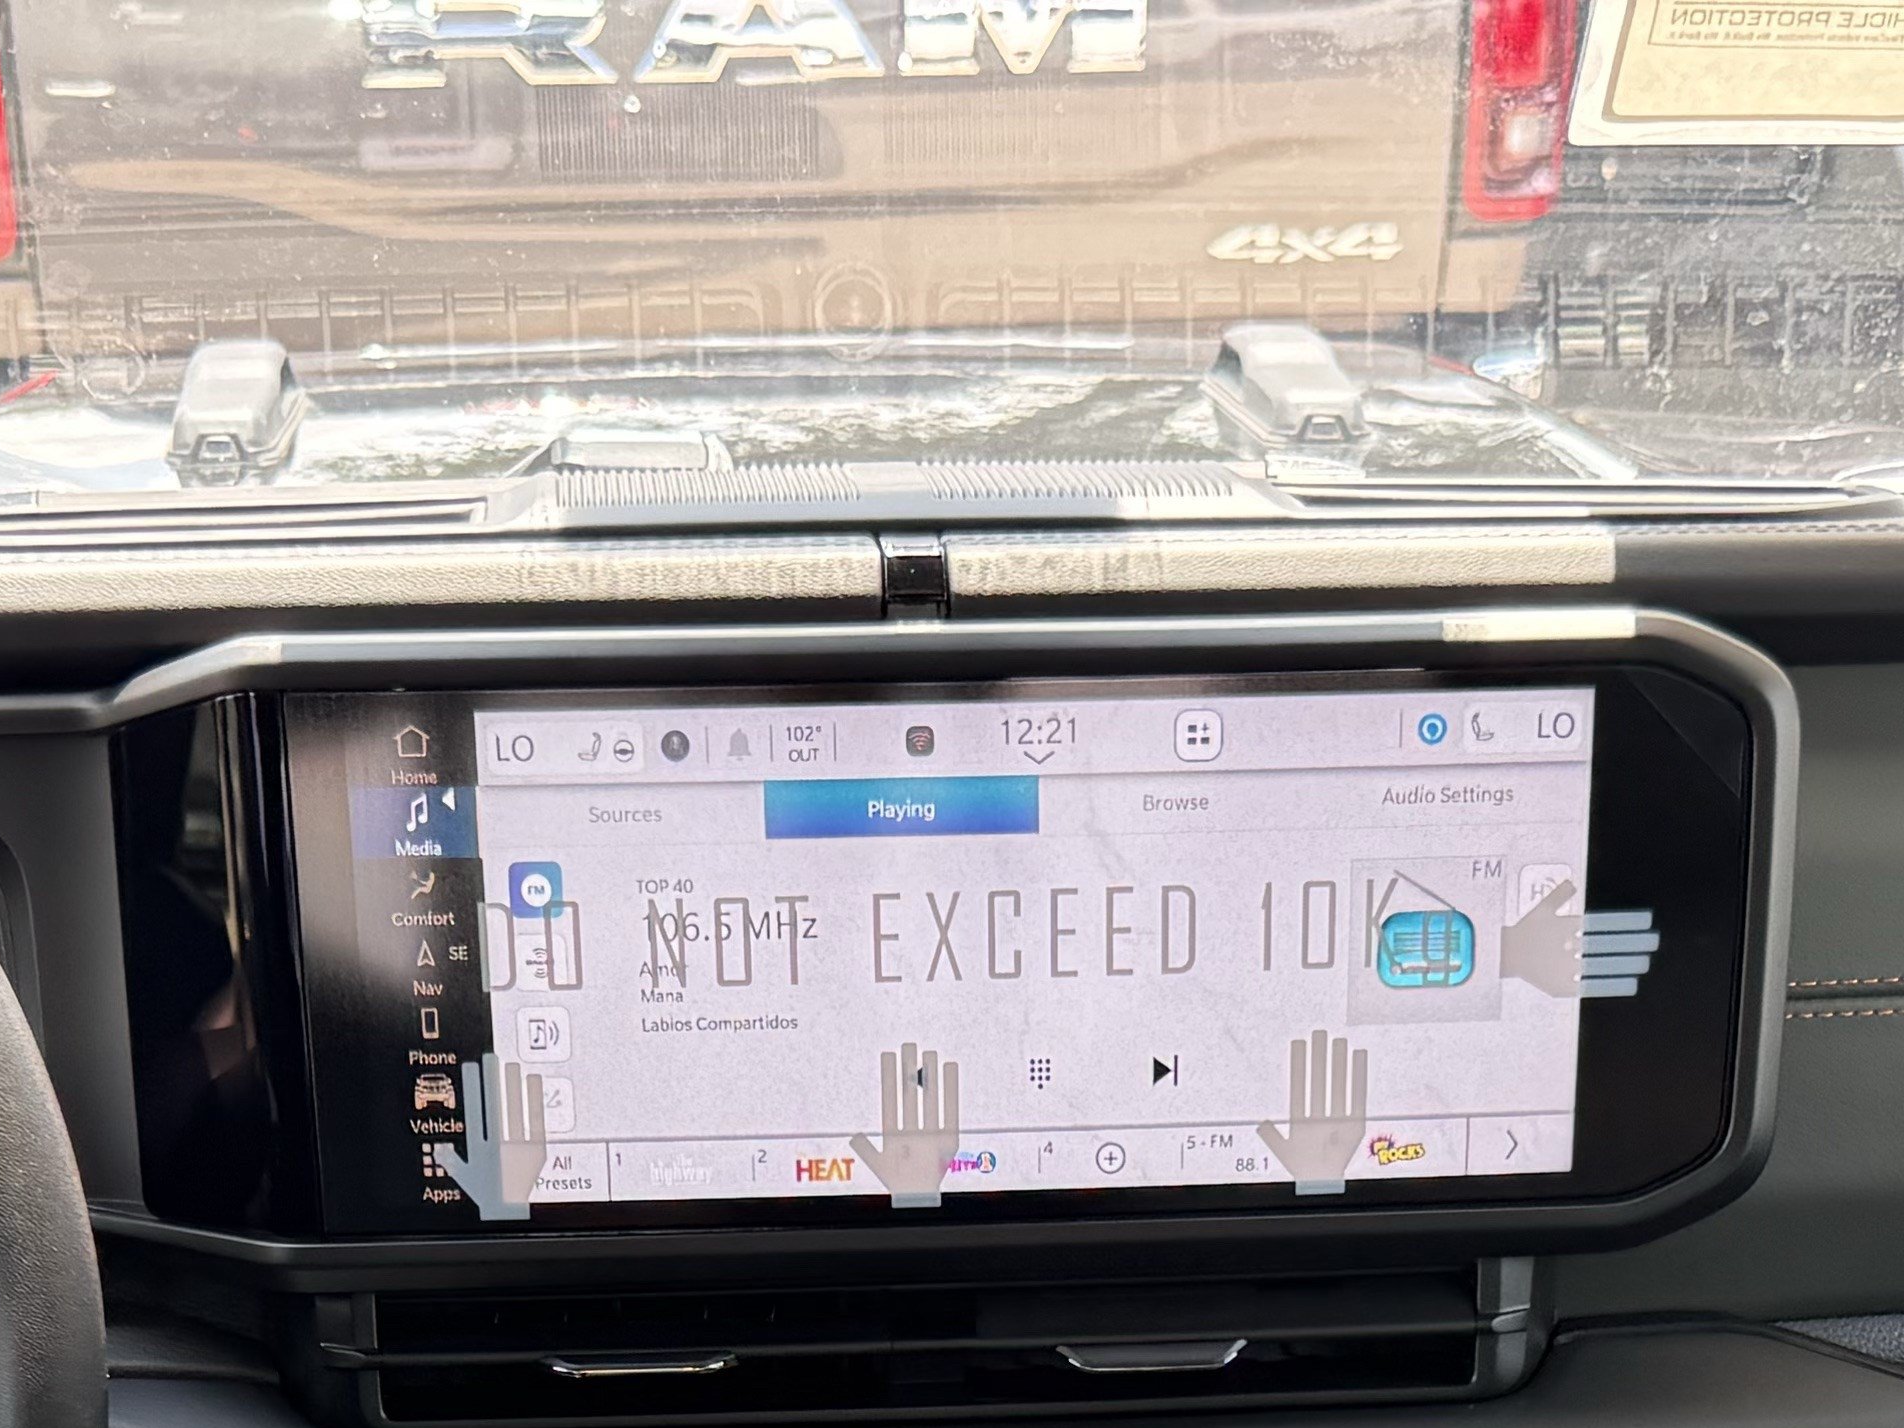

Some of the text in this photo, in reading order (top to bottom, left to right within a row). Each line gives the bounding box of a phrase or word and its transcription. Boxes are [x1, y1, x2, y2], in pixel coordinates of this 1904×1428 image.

[1208, 221, 1403, 263] 4x4
[1001, 718, 1077, 746] 12:21
[1536, 712, 1575, 739] LO
[494, 734, 534, 763] LO
[788, 748, 819, 763] OUT
[391, 770, 438, 785] Home
[1143, 794, 1210, 812] Browse
[1382, 784, 1515, 806] Audio Settings
[589, 806, 663, 824] Sources
[868, 800, 936, 821] Playing
[395, 839, 443, 857] Media
[1472, 860, 1502, 880] FM
[636, 879, 695, 894] TOP 40
[392, 911, 456, 927] Comfort
[642, 911, 819, 942] 106.5 MHz
[477, 901, 583, 992] DO
[647, 895, 809, 988] NOT
[872, 885, 1197, 983] EXCEED
[448, 946, 469, 962] SE
[414, 981, 444, 997] Nav
[641, 988, 685, 1003] Mana
[642, 1014, 799, 1033] Labios Compartidos
[409, 1050, 457, 1066] Phone
[410, 1118, 464, 1134] Vehicle
[1043, 1140, 1054, 1155] 4
[1187, 1136, 1196, 1150] 5
[1210, 1134, 1234, 1149] FM
[552, 1155, 572, 1171] All
[757, 1149, 768, 1164] 2
[1235, 1157, 1270, 1173] 88.1
[796, 1158, 856, 1182] HEAT
[535, 1176, 593, 1191] Presets
[423, 1186, 461, 1205] Apps
